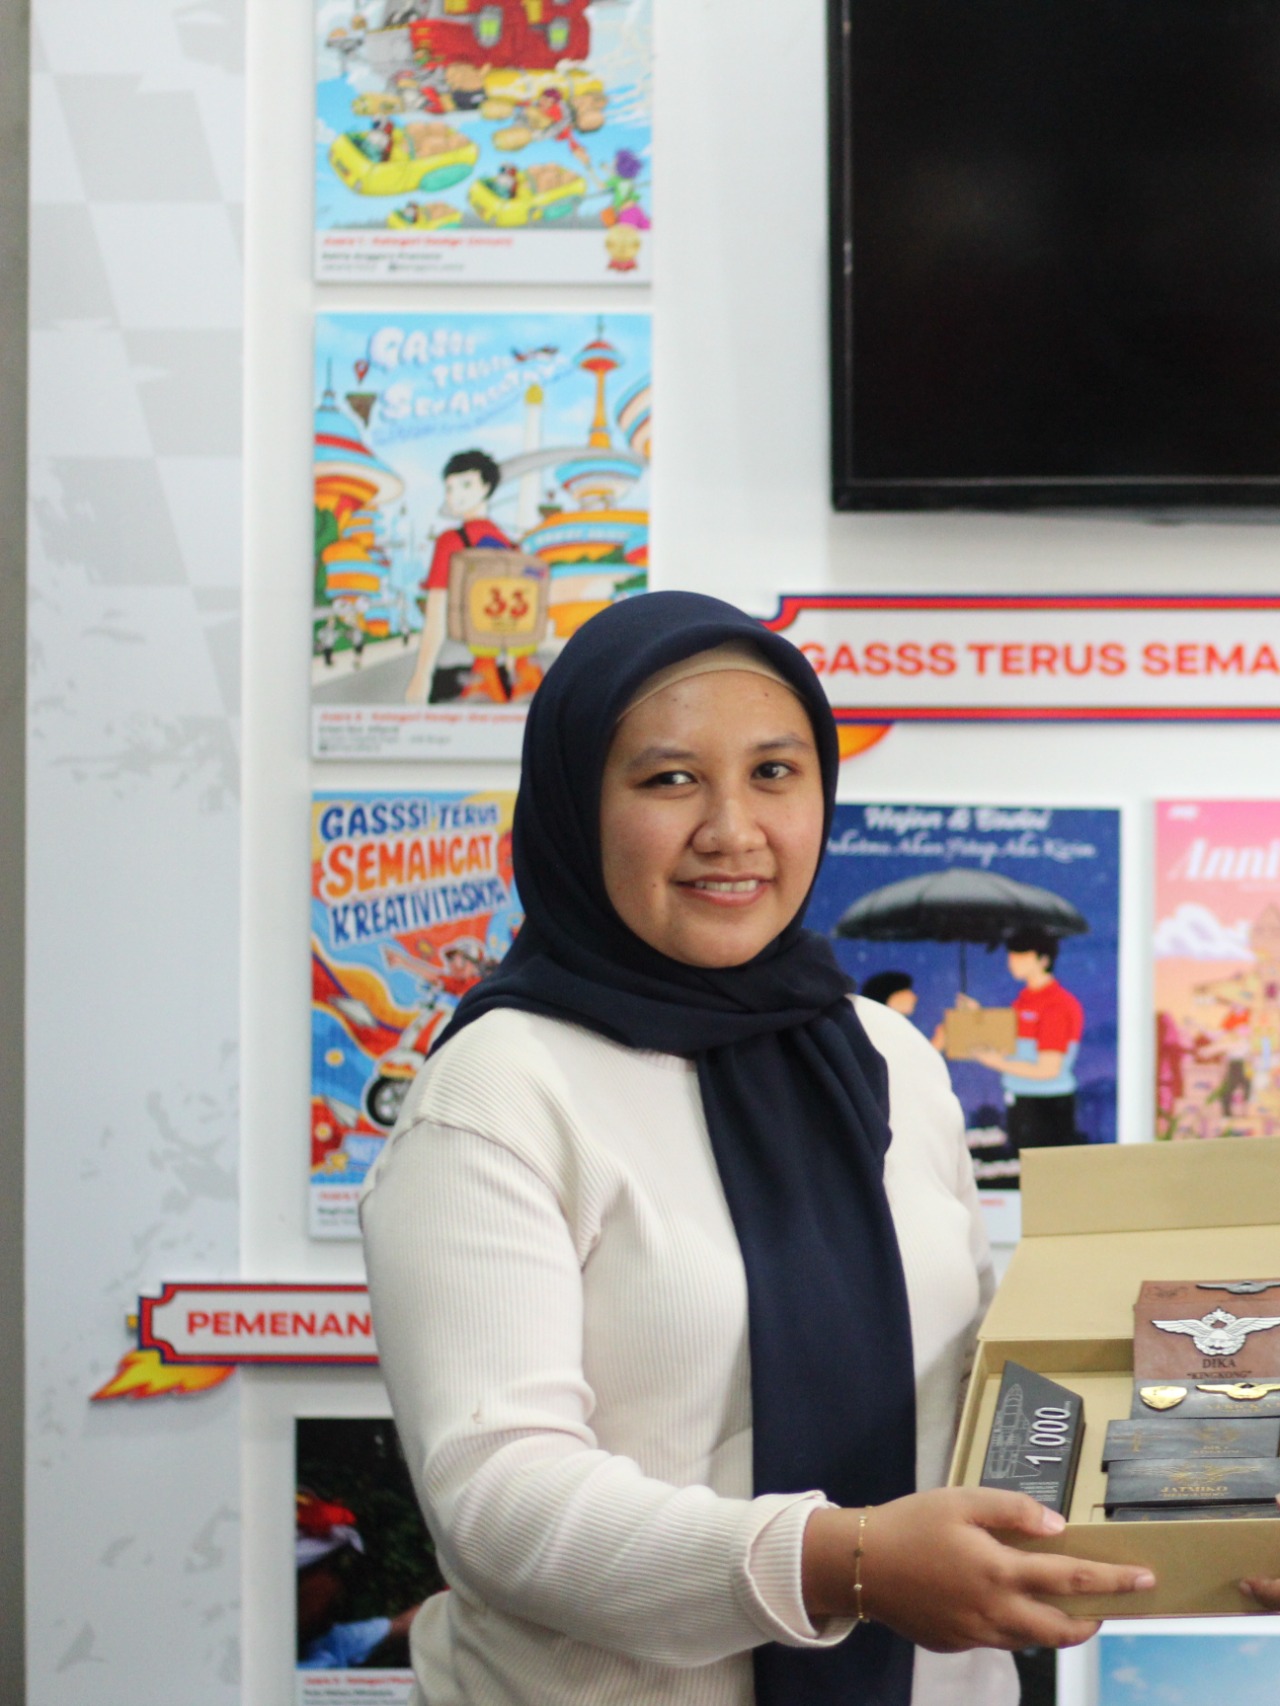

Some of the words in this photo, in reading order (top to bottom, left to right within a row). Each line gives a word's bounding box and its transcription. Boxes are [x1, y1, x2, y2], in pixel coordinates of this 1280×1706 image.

[800, 643, 957, 676] GASSS
[967, 643, 1128, 676] TERUS
[325, 835, 493, 897] SEMANGAT
[187, 1311, 372, 1337] PEMENAN
[1202, 1358, 1236, 1369] DIKA
